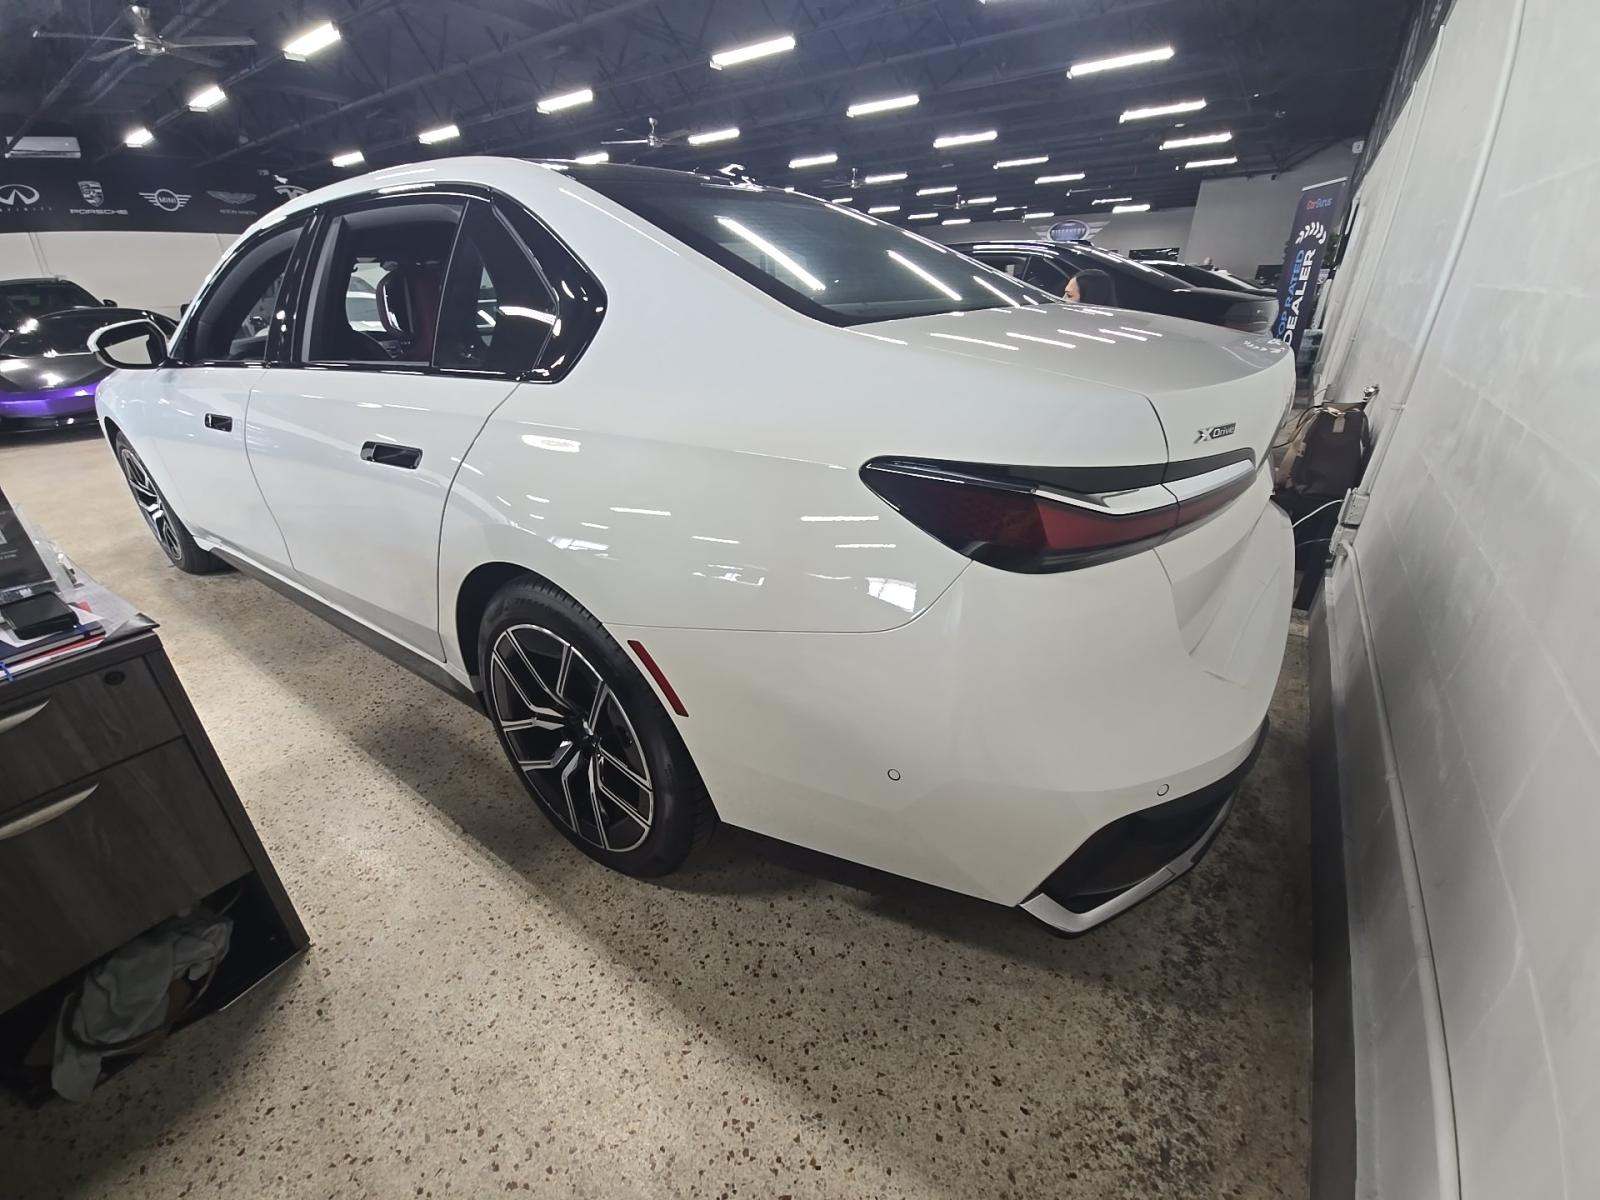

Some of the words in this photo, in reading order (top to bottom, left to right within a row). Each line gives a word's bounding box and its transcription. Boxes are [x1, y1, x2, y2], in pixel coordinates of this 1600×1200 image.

[1277, 310, 1288, 339] OP
[1284, 249, 1305, 307] RATED
[1283, 248, 1316, 346] DEALER
